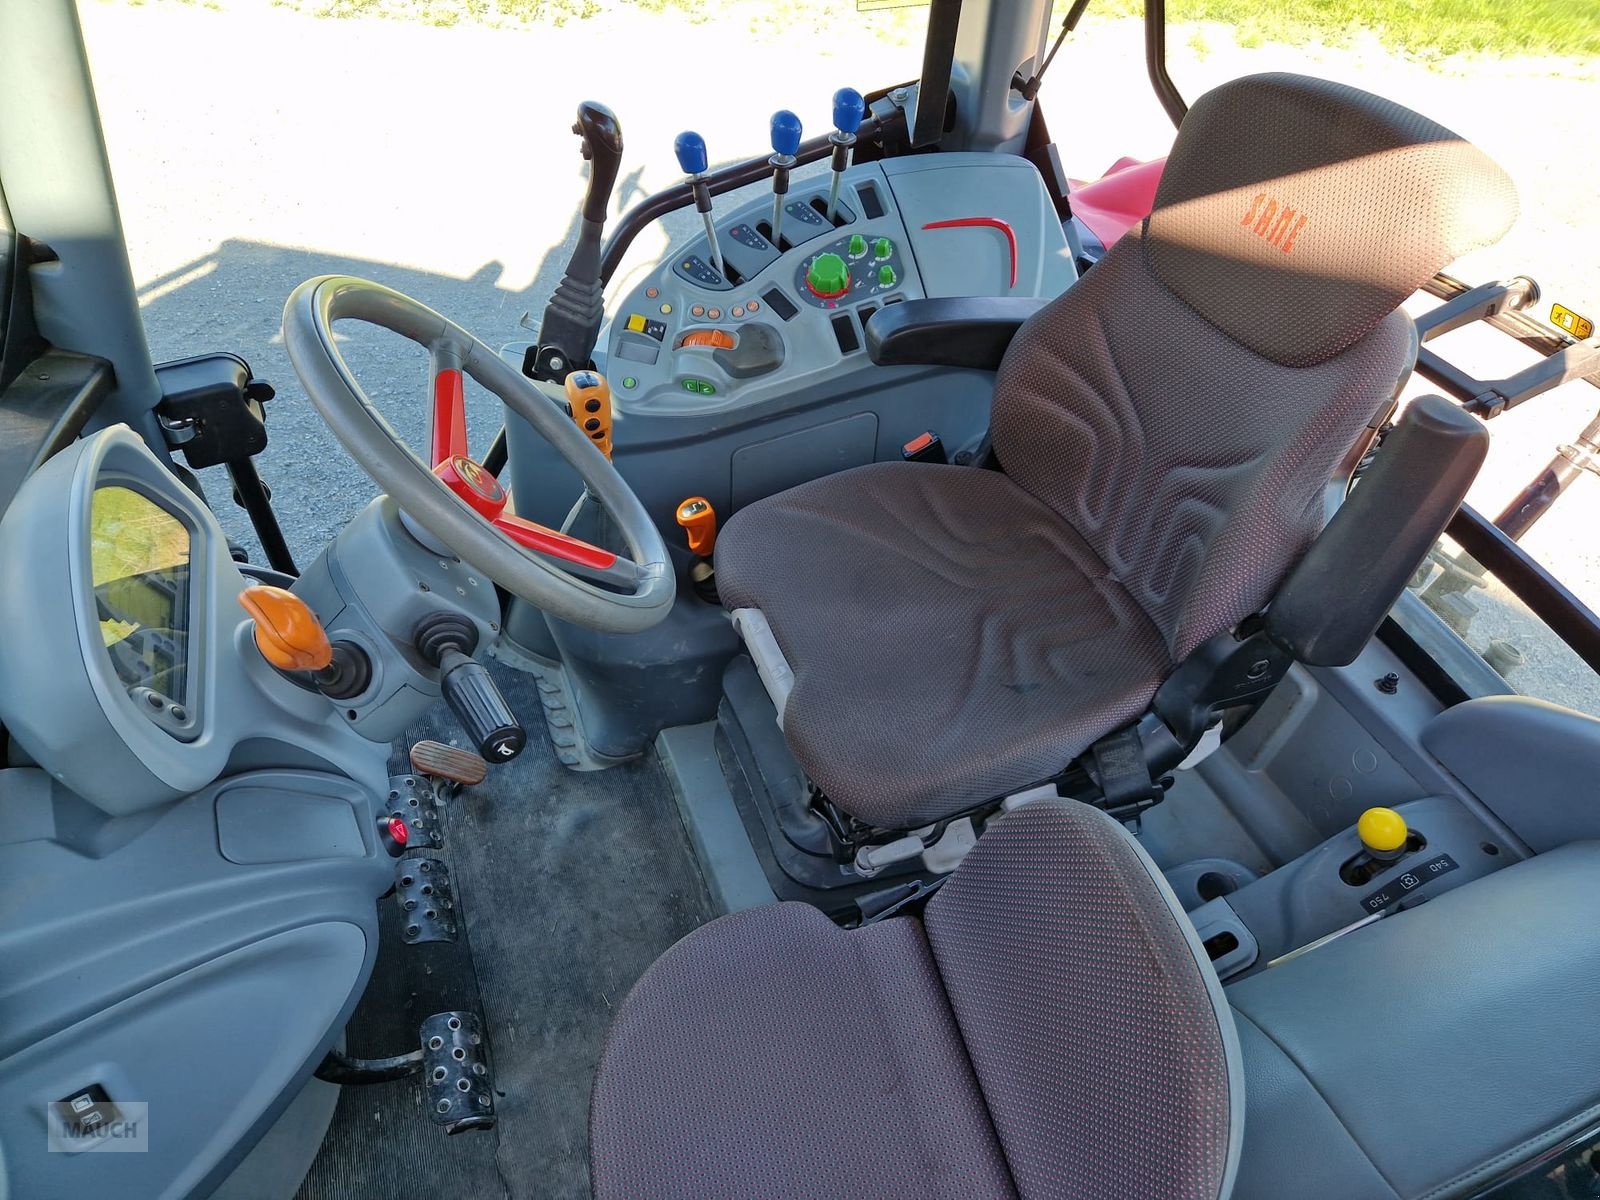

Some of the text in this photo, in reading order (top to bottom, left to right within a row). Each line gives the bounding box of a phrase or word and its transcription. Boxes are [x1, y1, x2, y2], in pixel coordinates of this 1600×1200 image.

[1240, 193, 1308, 254] SAME
[1429, 860, 1449, 872] 540
[1369, 893, 1389, 908] 750
